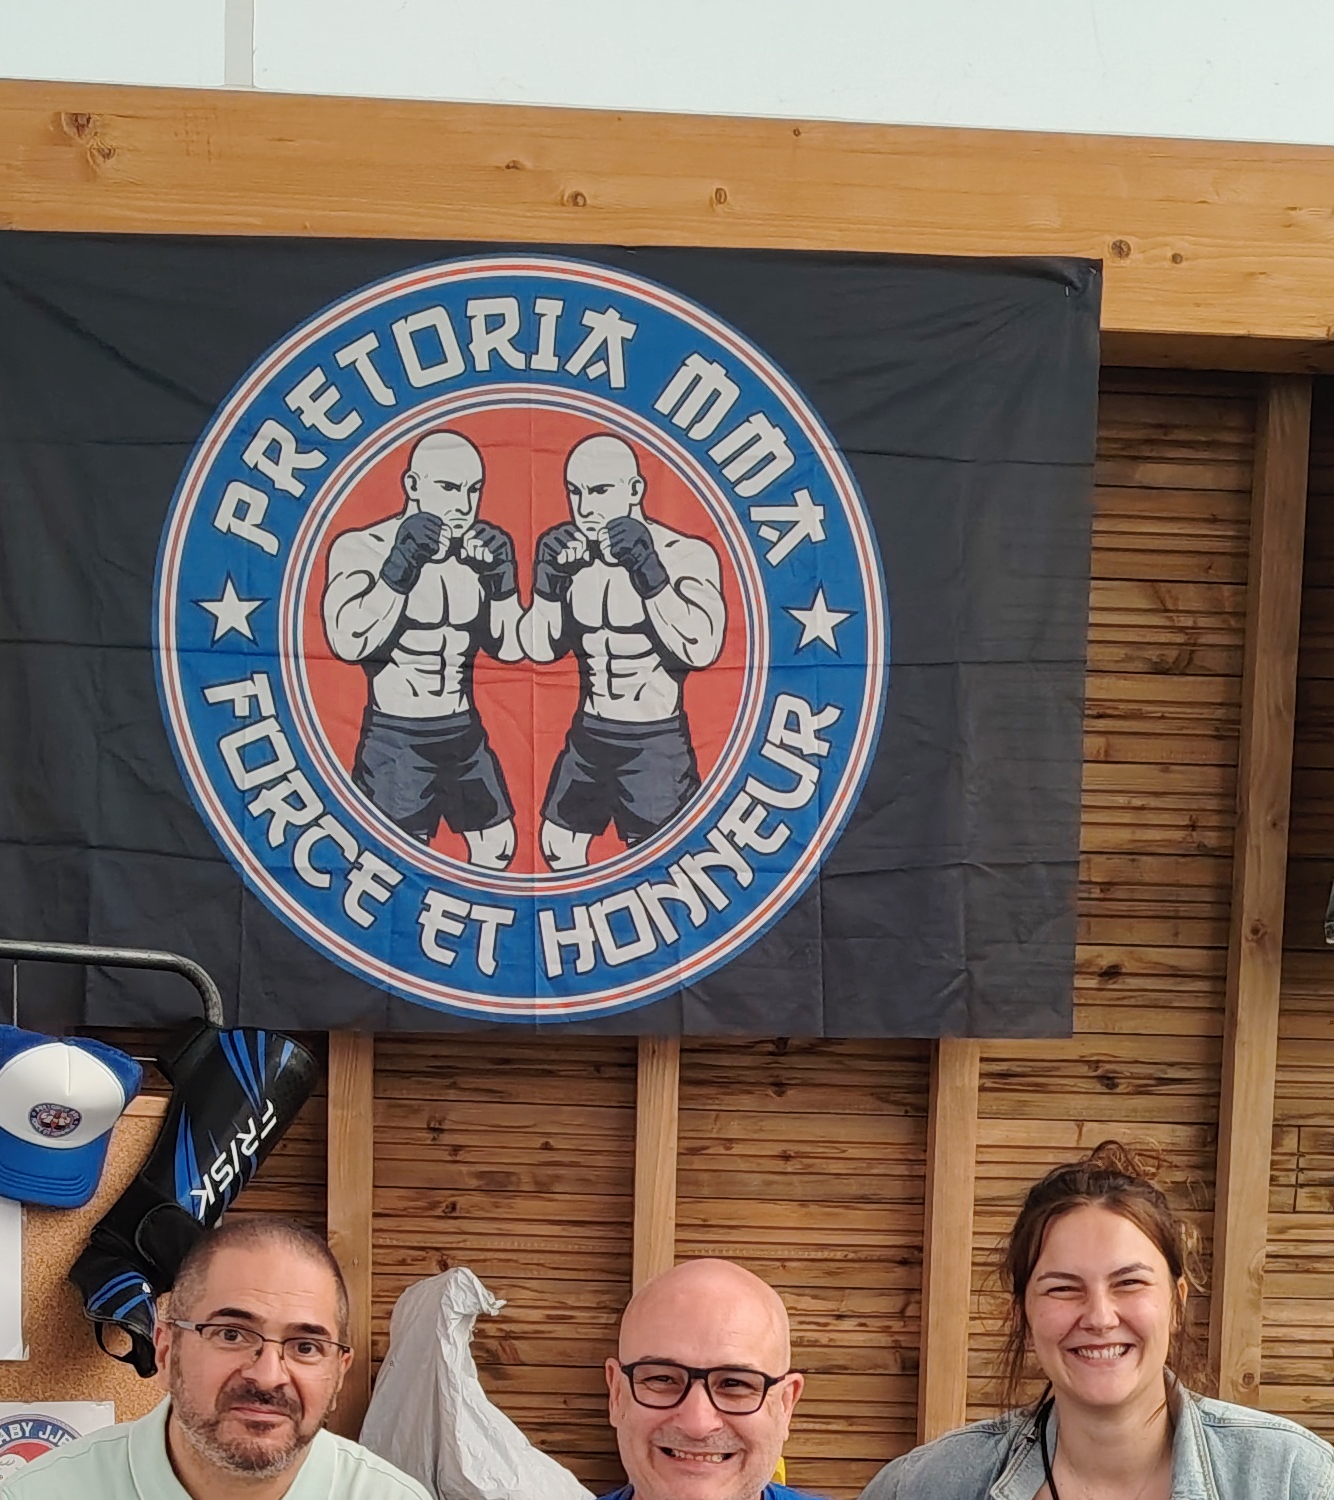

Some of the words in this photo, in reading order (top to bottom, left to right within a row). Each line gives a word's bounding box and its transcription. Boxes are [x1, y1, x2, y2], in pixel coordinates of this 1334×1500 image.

[213, 297, 636, 555] PRETORIA
[653, 351, 829, 568] MMA
[204, 672, 402, 928] FORCE
[417, 897, 514, 977] ET
[539, 691, 845, 979] HONNEUR
[189, 1098, 279, 1220] FRISK
